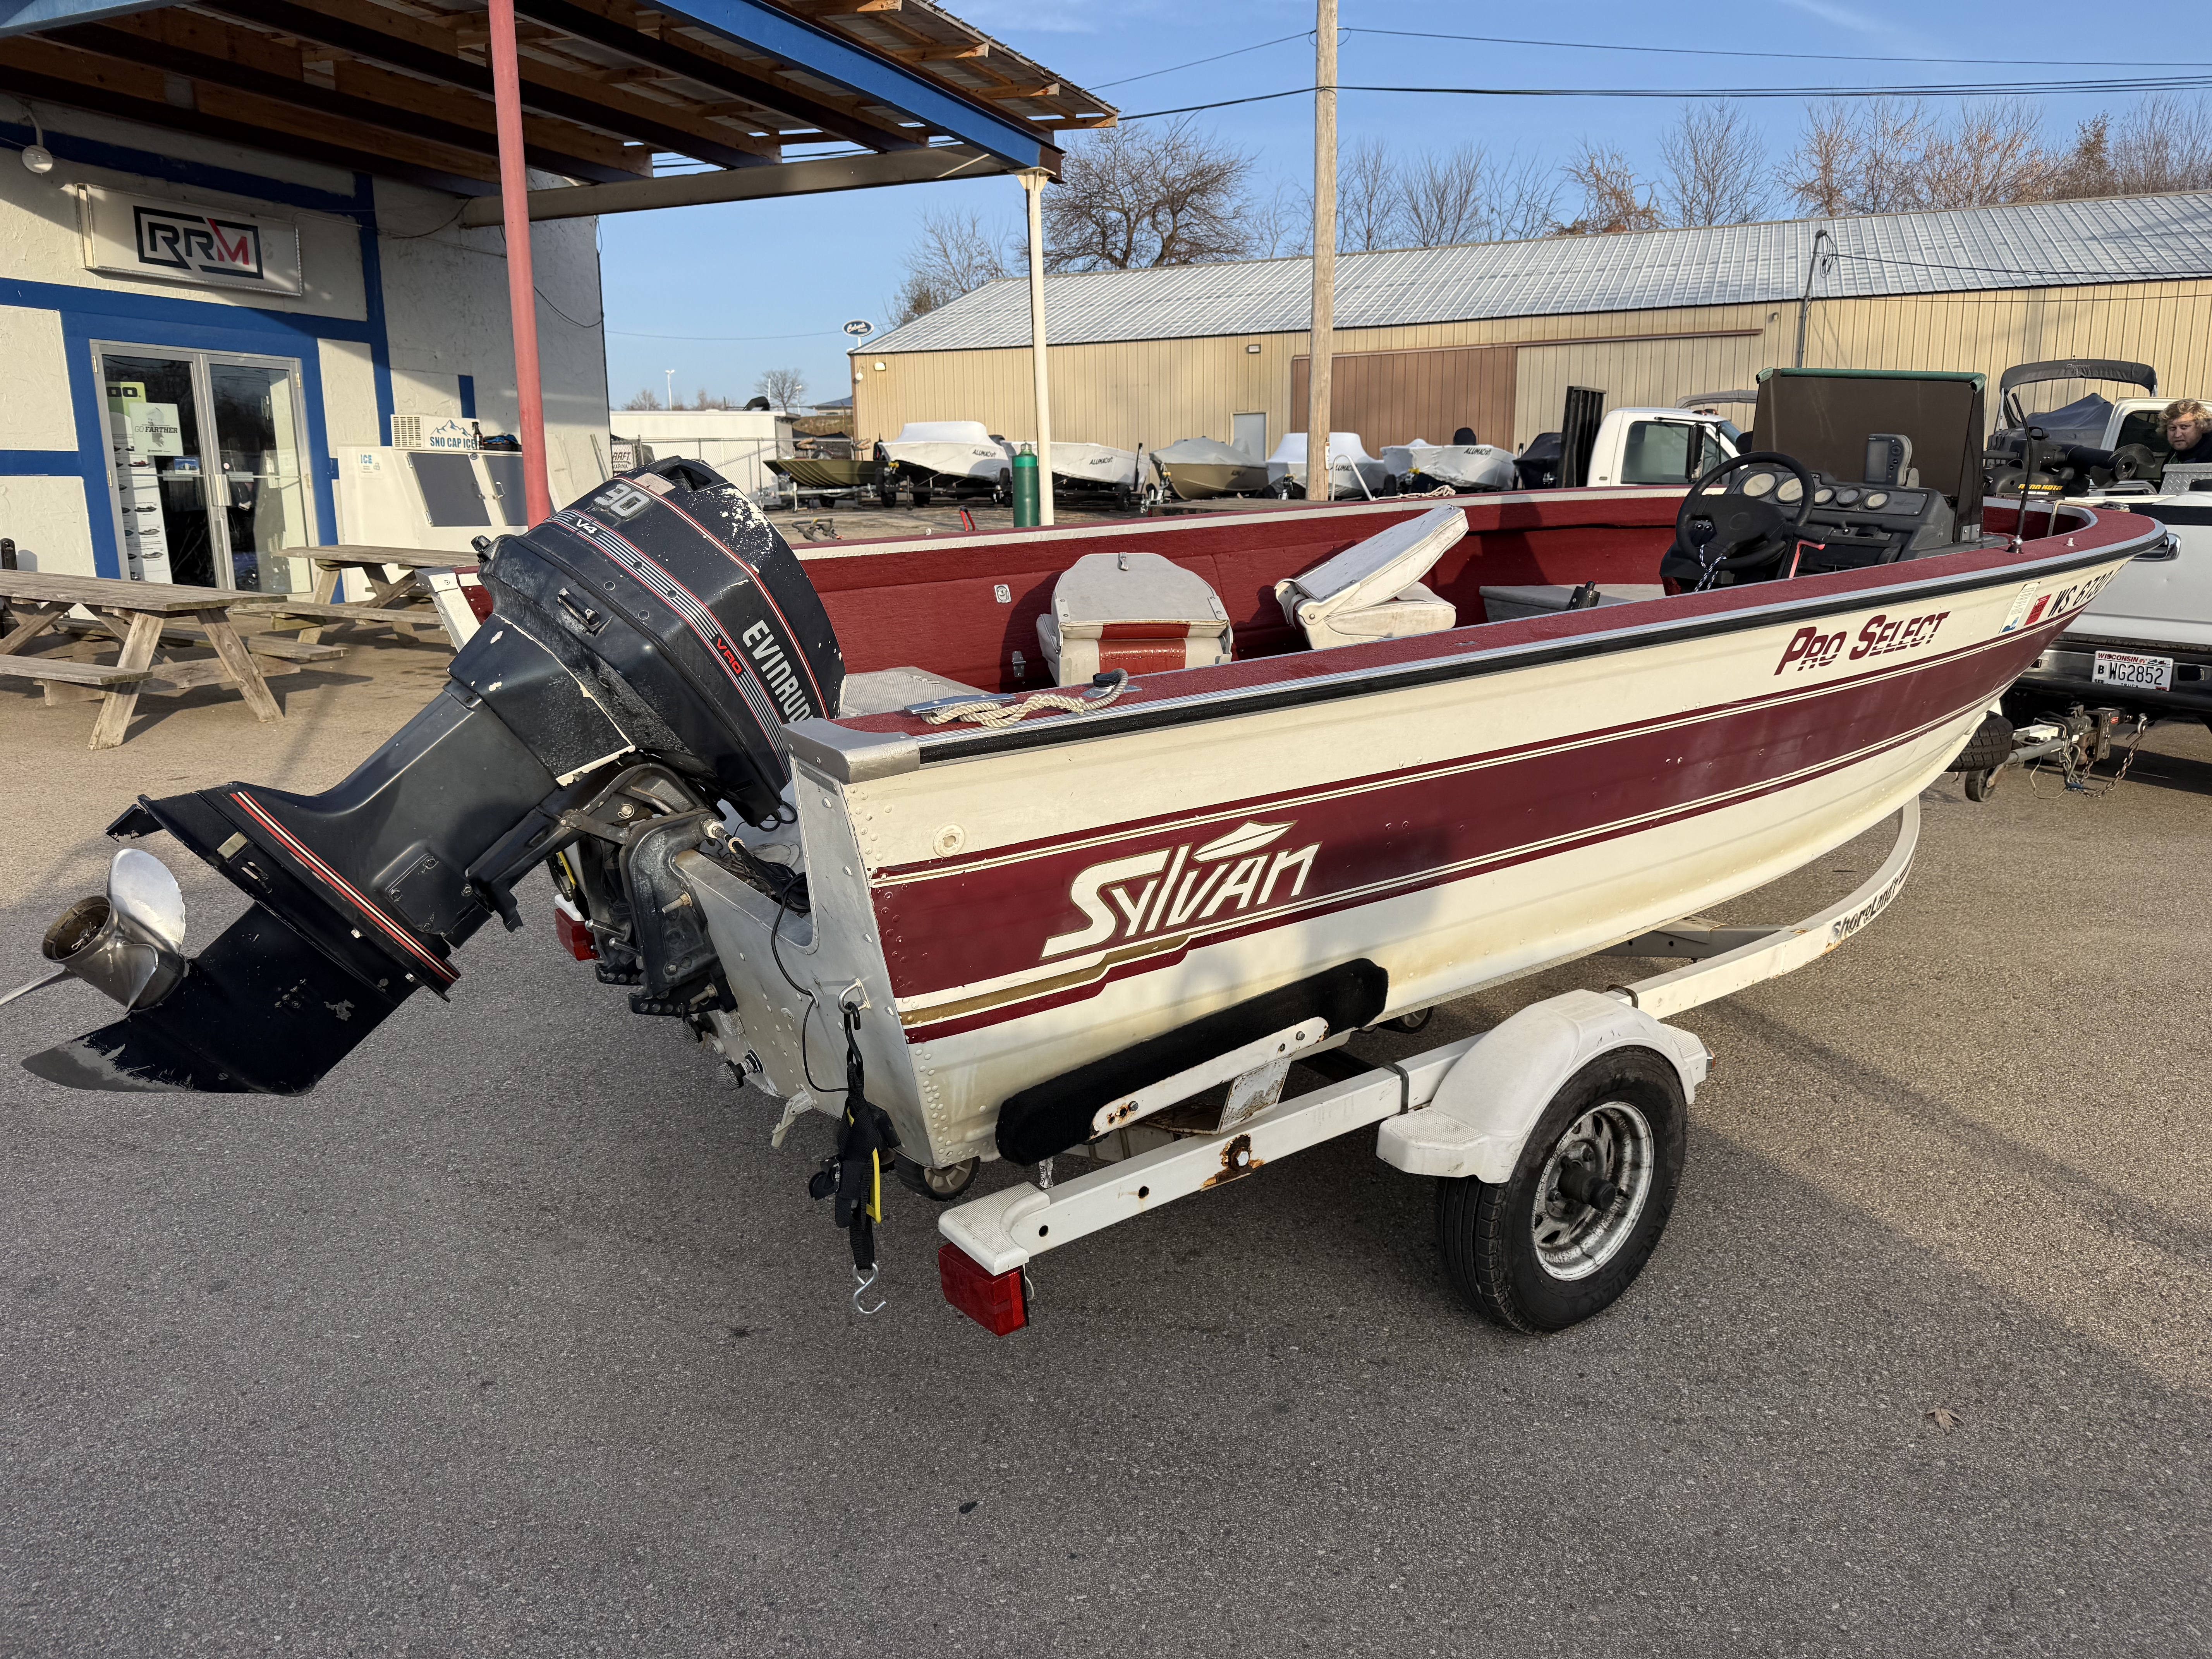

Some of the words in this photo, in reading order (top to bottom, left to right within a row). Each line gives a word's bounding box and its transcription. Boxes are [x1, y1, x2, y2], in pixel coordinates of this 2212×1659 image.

[148, 218, 250, 266] RRM
[430, 436, 445, 447] SNO
[447, 437, 461, 448] CAP
[361, 454, 373, 464] ICE
[594, 483, 651, 518] 90
[576, 519, 598, 534] V4
[2047, 585, 2078, 618] WS
[716, 637, 742, 675] VRO
[2098, 653, 2139, 663] WISCONSIN
[742, 620, 814, 723] EVINRUD
[2097, 665, 2105, 674] B
[2109, 662, 2163, 685] WG2852
